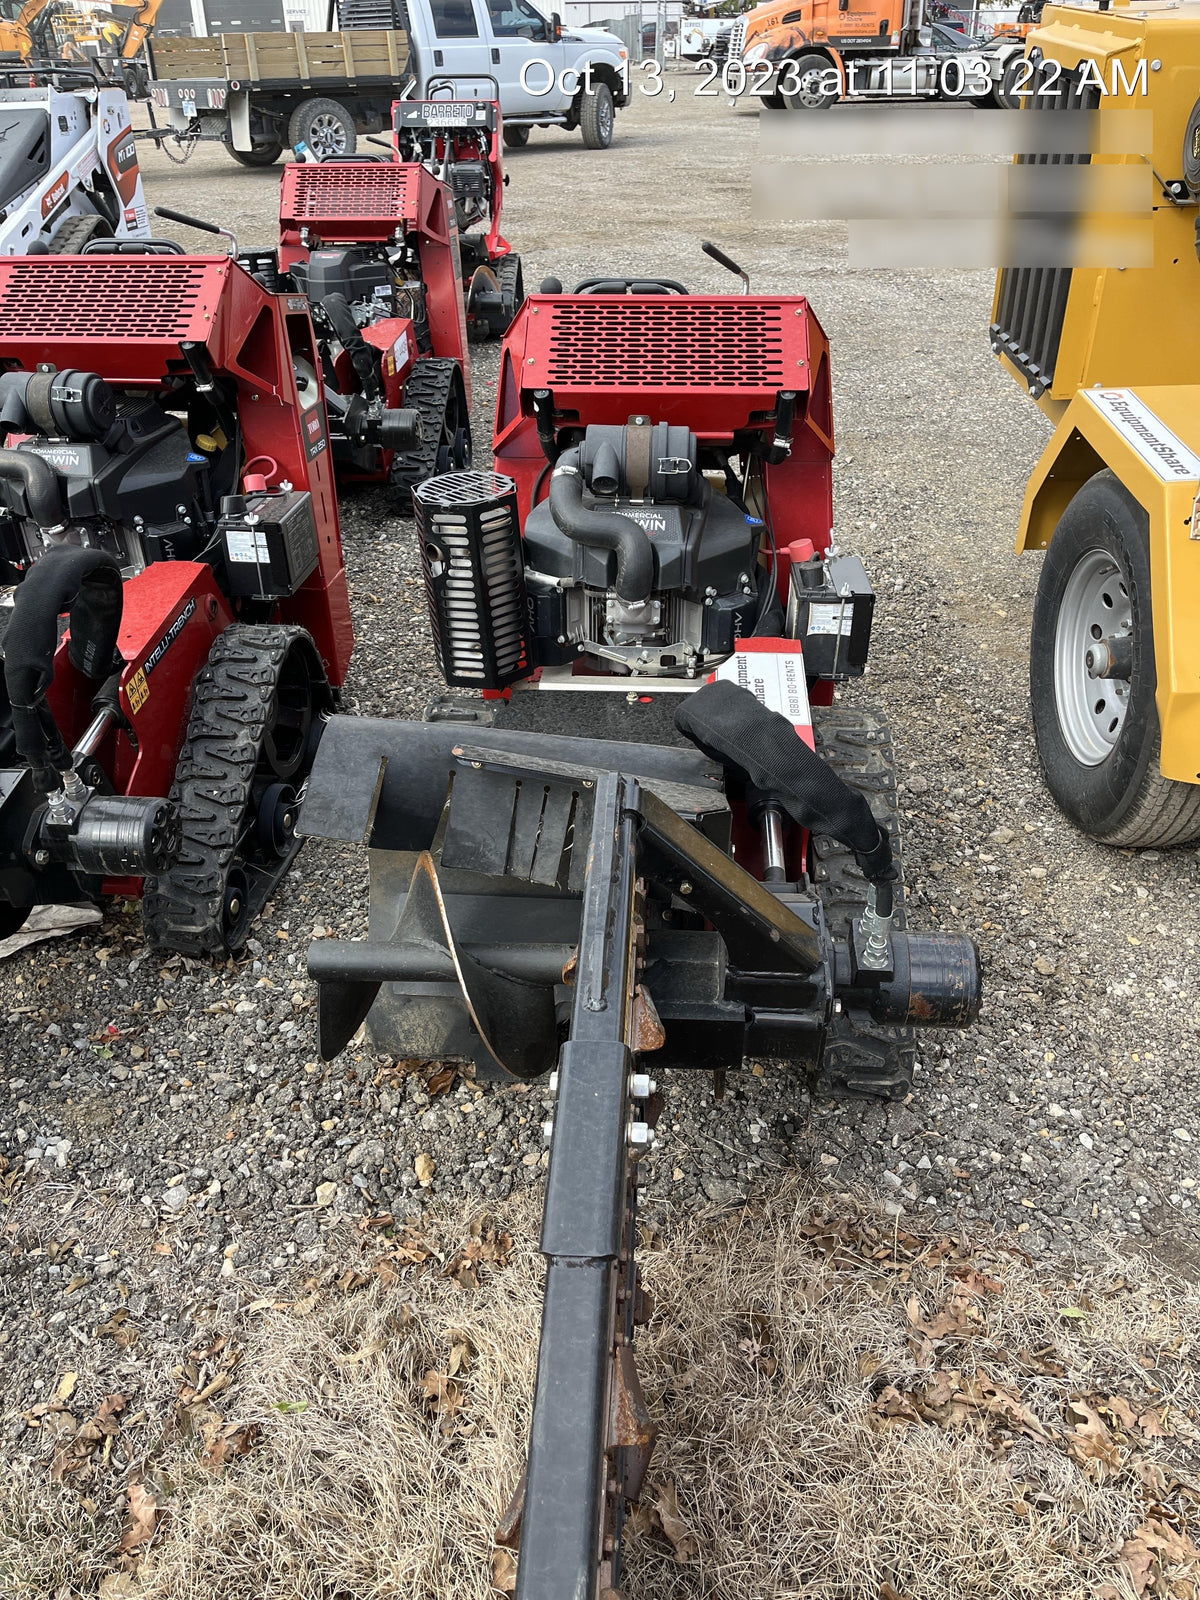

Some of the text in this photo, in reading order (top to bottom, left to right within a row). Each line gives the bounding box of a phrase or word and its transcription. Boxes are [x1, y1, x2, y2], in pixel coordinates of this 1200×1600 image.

[766, 17, 780, 26] 161
[422, 104, 474, 119] BARRETO
[307, 418, 320, 435] TORO
[1109, 401, 1191, 476] EquipmentShare
[611, 511, 664, 520] MMERCIAL
[145, 597, 196, 674] INTELLI-TRENCH
[784, 660, 798, 695] 80-RENTS
